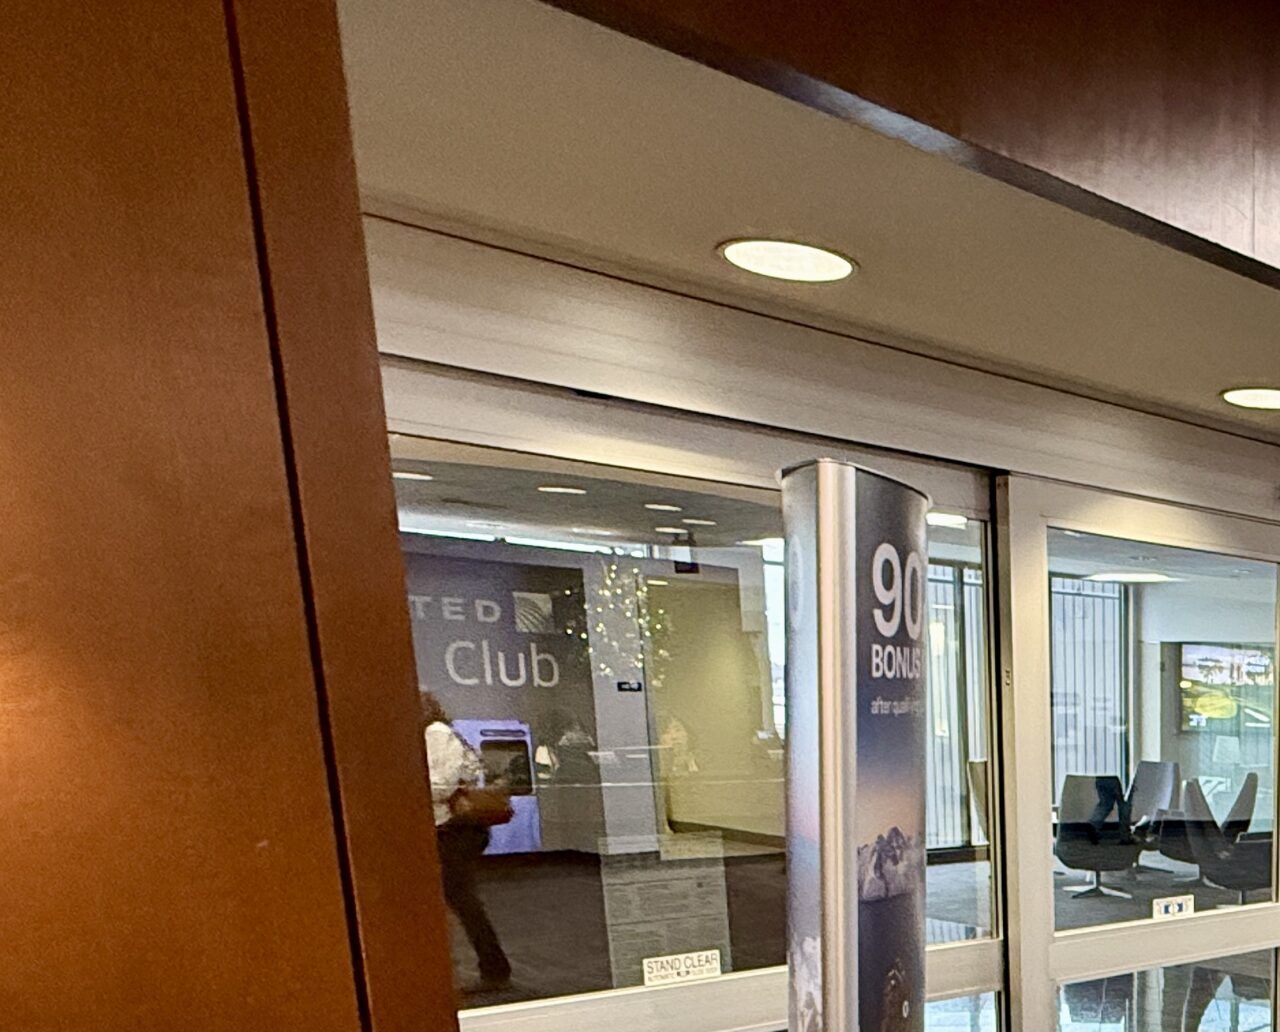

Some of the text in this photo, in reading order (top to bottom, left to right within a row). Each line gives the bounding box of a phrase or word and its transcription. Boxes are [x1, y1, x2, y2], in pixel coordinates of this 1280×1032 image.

[408, 595, 501, 623] TED
[872, 543, 922, 640] 90
[445, 639, 559, 687] Club
[871, 644, 921, 680] BONUS
[647, 952, 718, 975] STAND CLEAR
